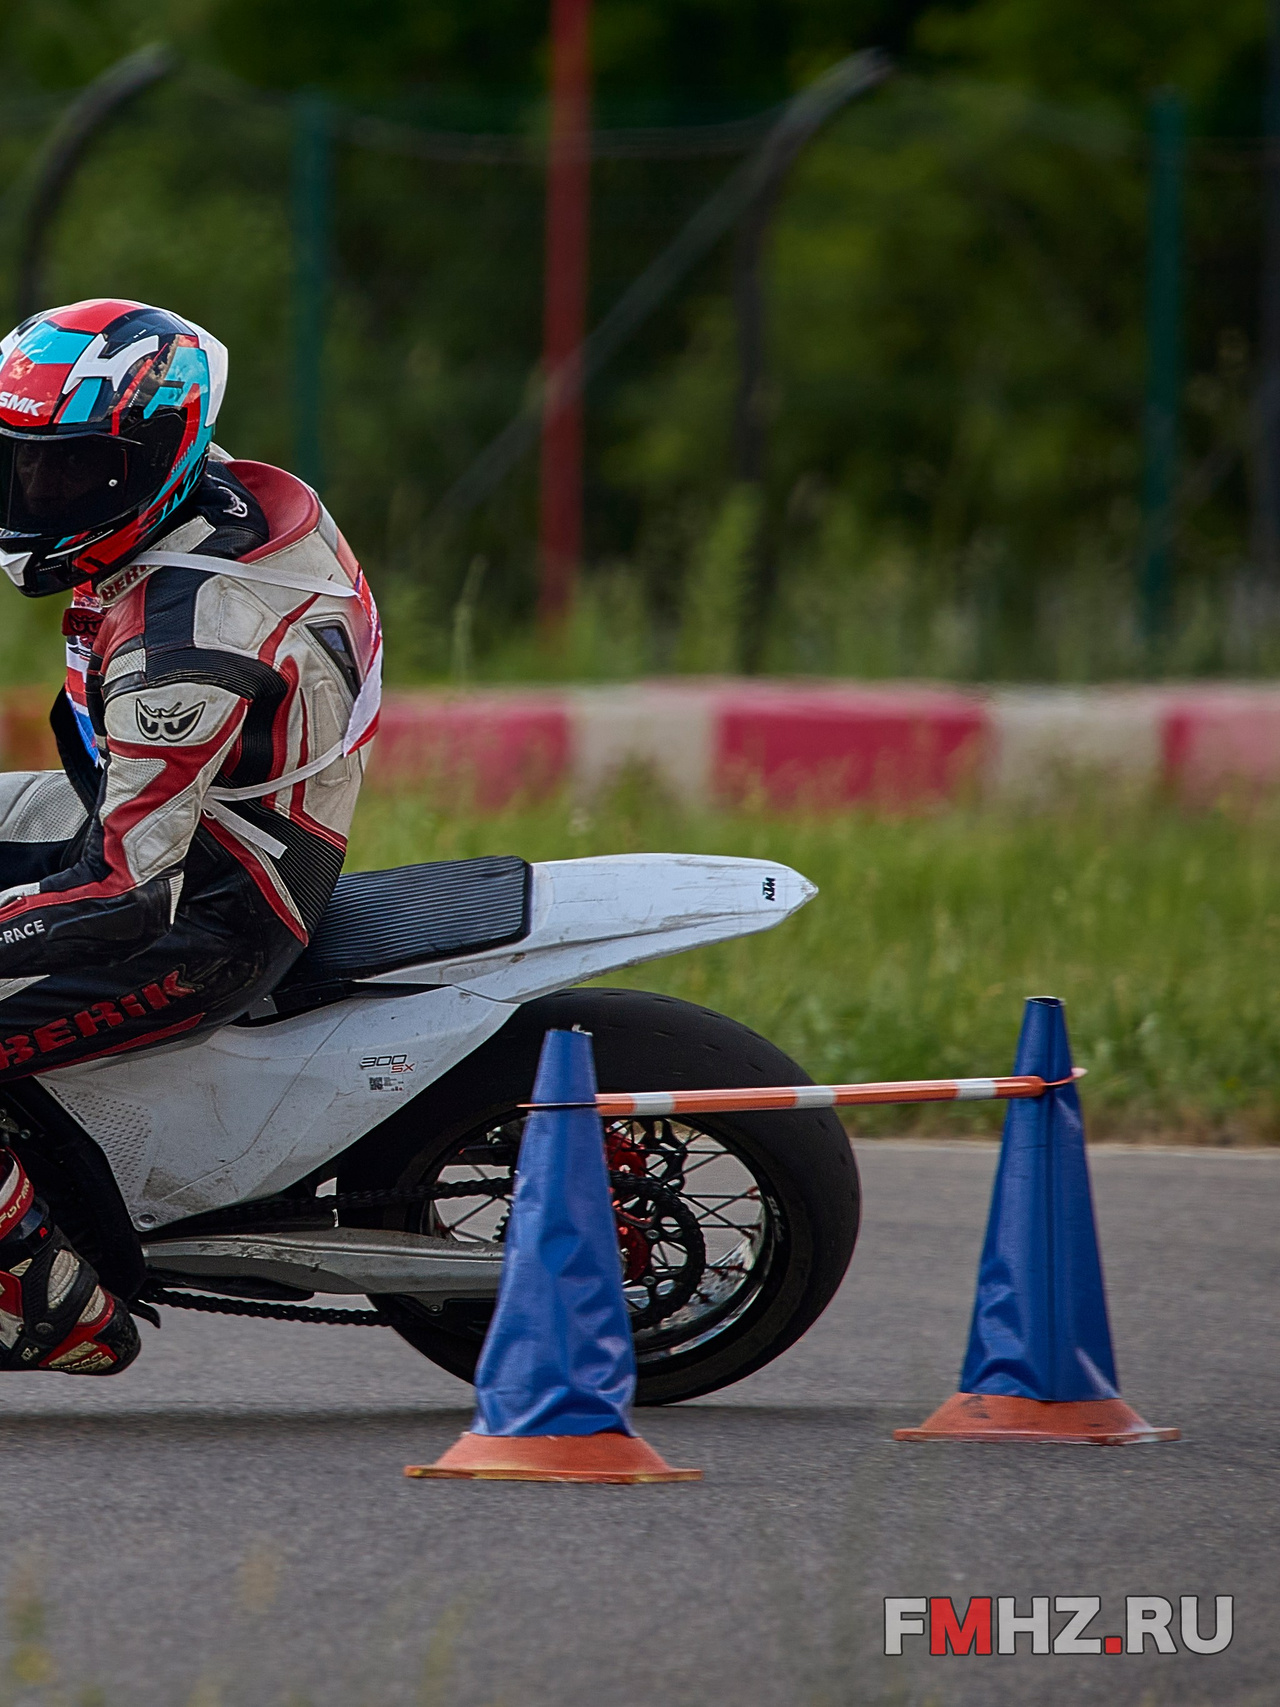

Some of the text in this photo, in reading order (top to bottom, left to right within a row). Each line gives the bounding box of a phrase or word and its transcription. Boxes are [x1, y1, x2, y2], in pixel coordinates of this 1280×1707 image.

[762, 877, 776, 901] KTM
[360, 1054, 407, 1068] 300
[391, 1063, 415, 1073] SX
